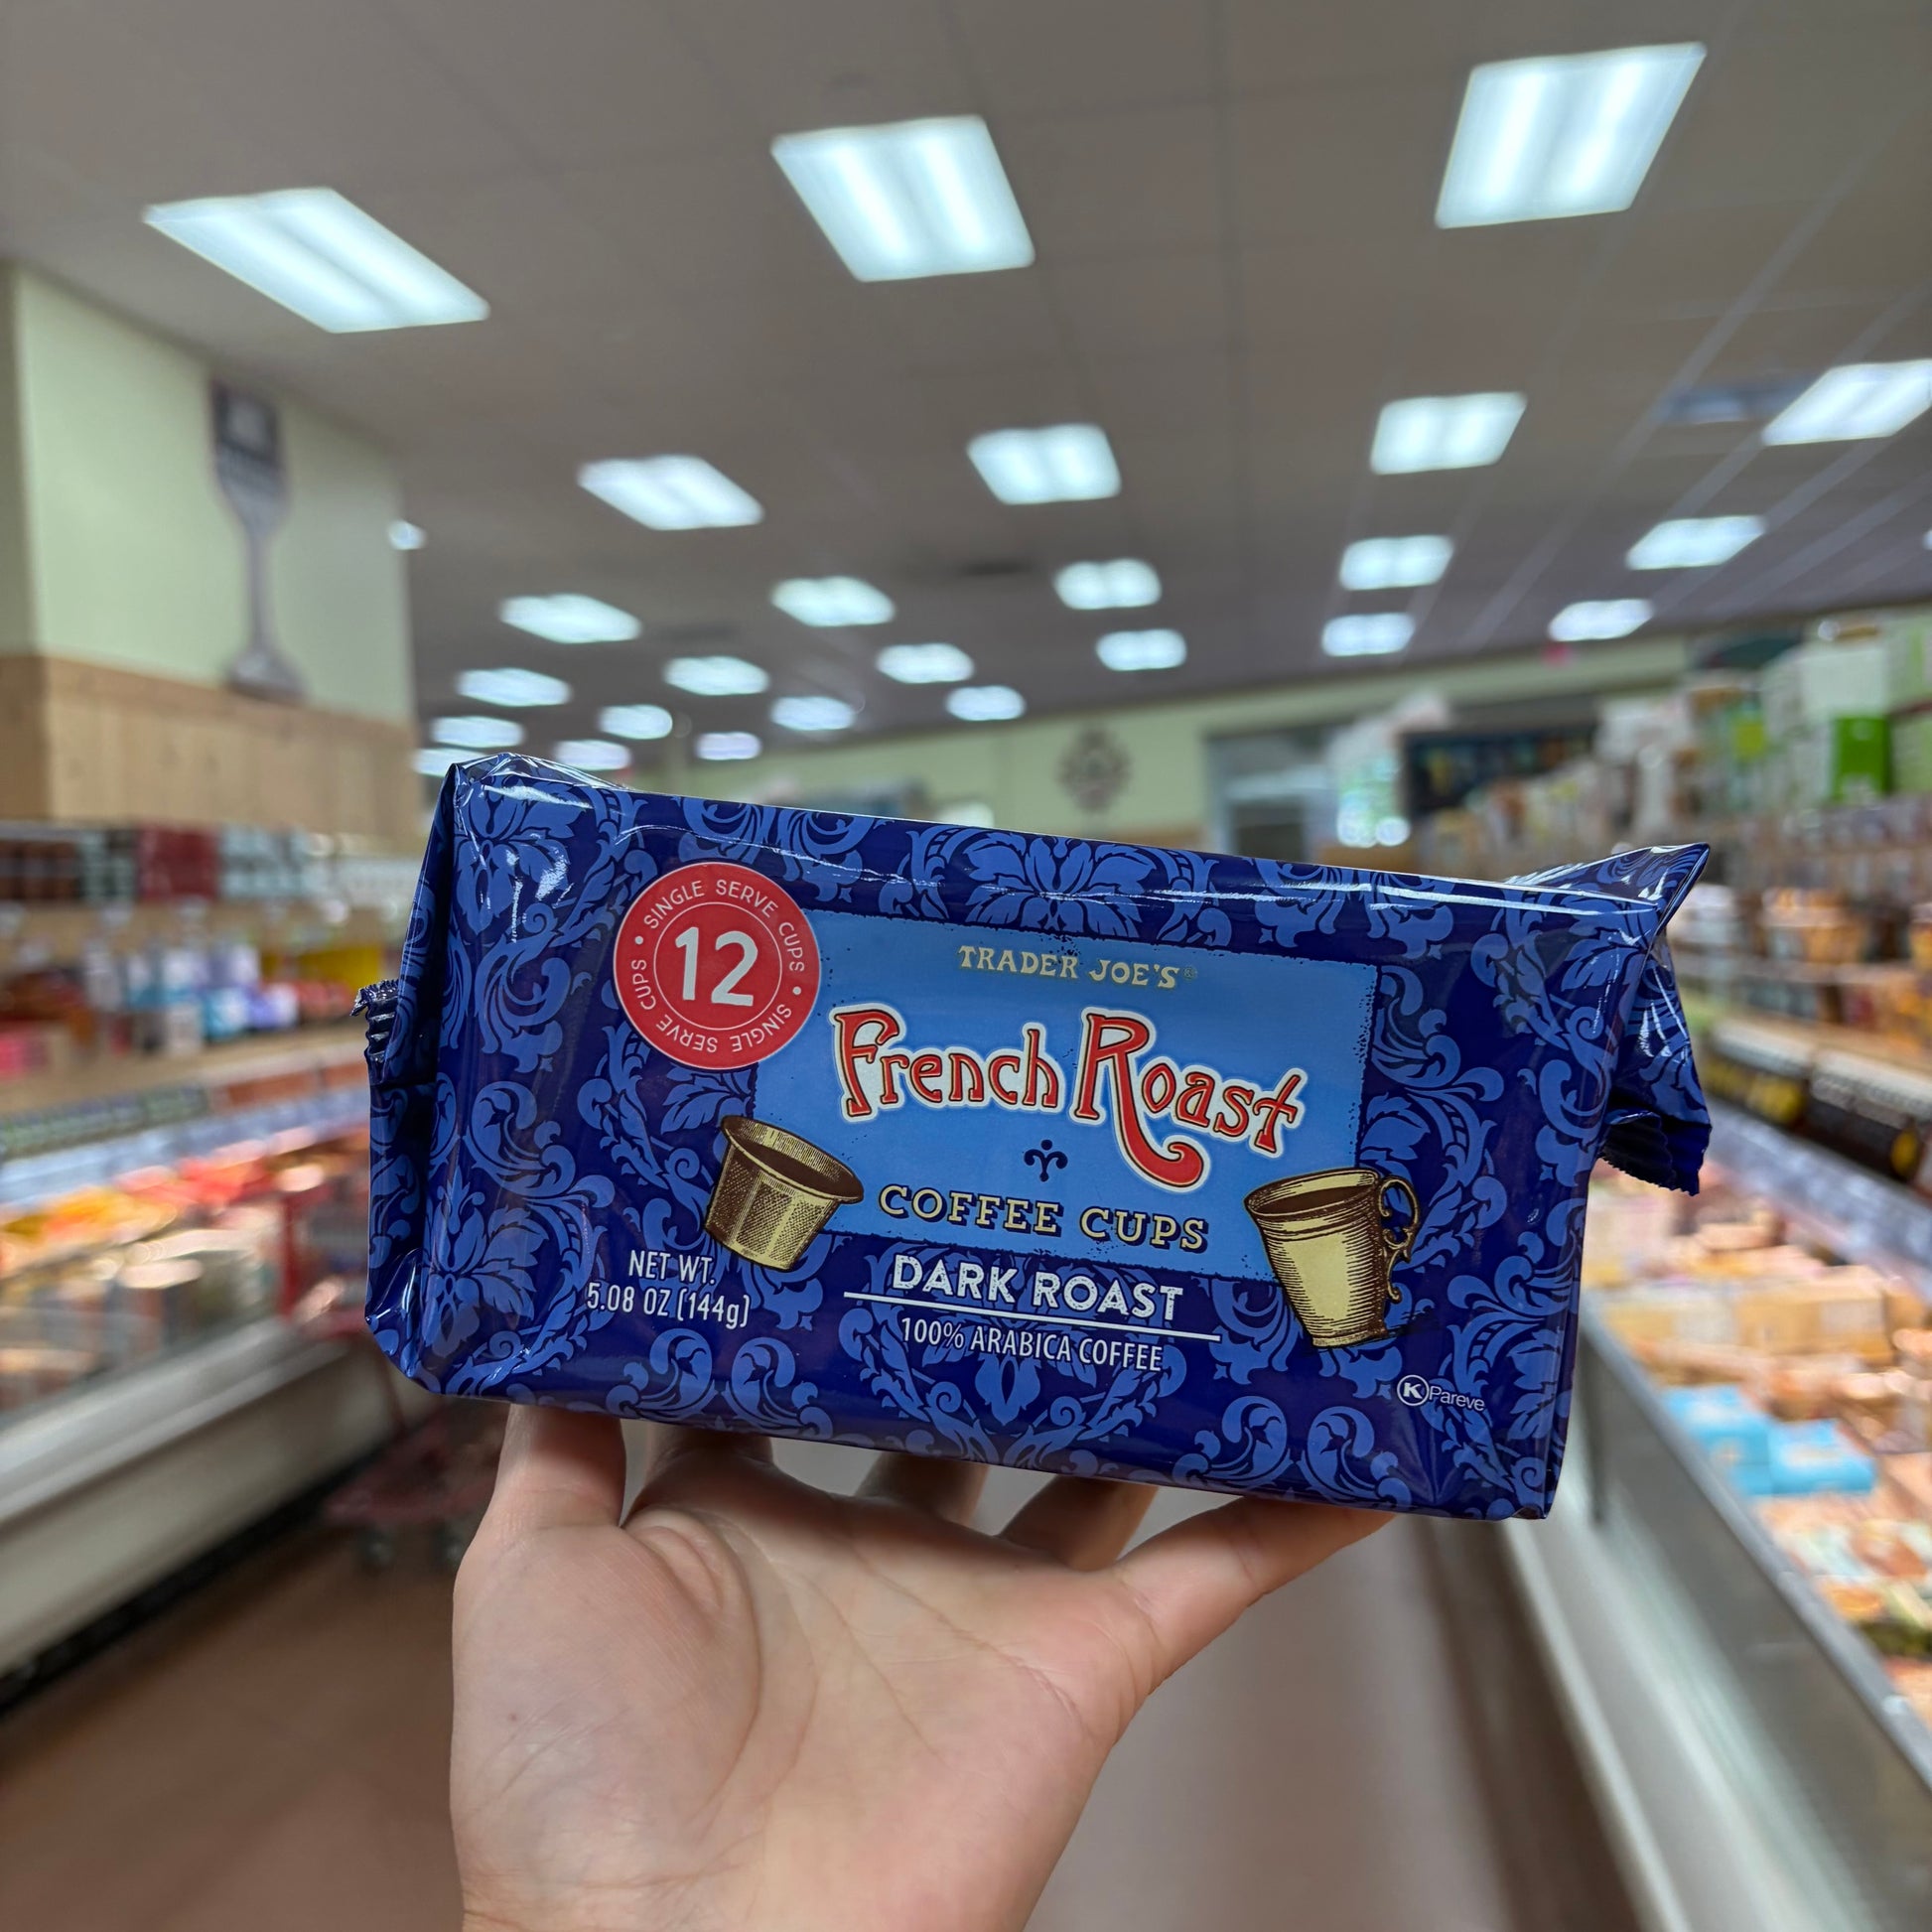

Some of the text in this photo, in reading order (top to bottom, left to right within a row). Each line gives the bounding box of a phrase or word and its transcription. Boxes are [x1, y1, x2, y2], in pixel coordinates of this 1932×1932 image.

[643, 879, 805, 972] SINGLE SERVE CUPS
[675, 926, 759, 1007] 12
[958, 945, 1078, 980] TRADER
[631, 959, 792, 1053] SINGLE SERVE CUPS
[832, 1006, 1305, 1188] French Roast
[879, 1185, 1209, 1253] COFFEE CUPS
[587, 1283, 634, 1312] 5.08
[643, 1288, 670, 1316] OZ
[628, 1250, 715, 1284] NET WT.
[893, 1254, 1183, 1320] DARK ROAST
[900, 1316, 1164, 1372] 100% ARABICA COFFEE
[1430, 1386, 1485, 1411] Pareve
